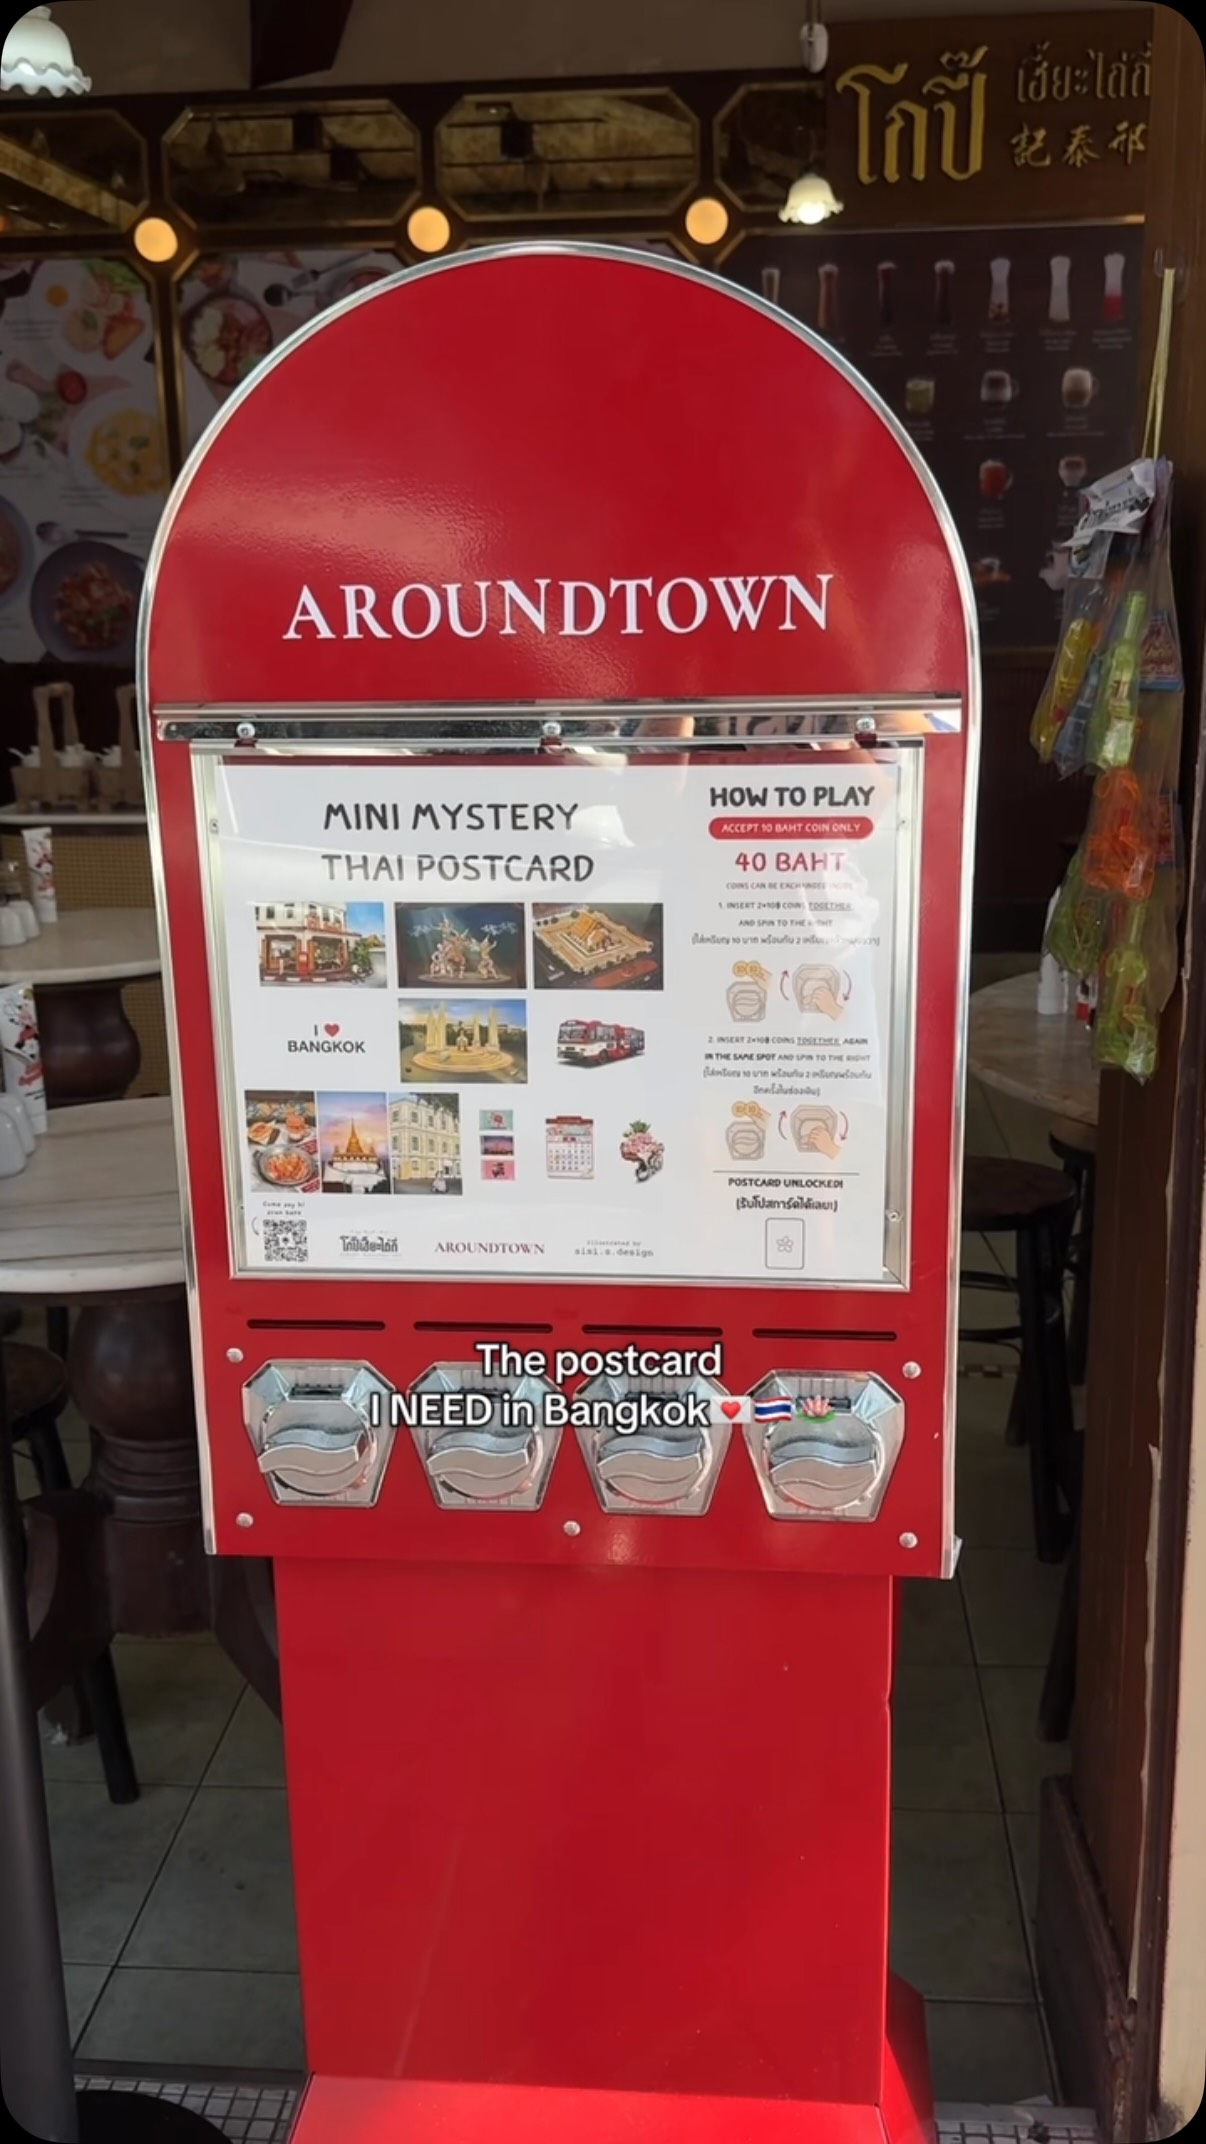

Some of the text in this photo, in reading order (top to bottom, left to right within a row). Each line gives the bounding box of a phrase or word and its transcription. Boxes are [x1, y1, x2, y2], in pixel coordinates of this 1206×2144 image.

[282, 573, 834, 641] AROUNDTOWN
[709, 785, 875, 807] HOW TO PLAY
[323, 803, 579, 831] MINI MYSTERY
[721, 822, 861, 833] ACCEPT 10 BAHT COIN ONLY
[321, 854, 595, 882] THAI POSTCARD
[735, 851, 846, 872] 40 BAHT
[739, 919, 756, 927] AND
[757, 919, 775, 927] SPIN
[777, 919, 788, 927] TO
[790, 919, 807, 927] THE
[314, 1023, 318, 1037] I
[287, 1039, 366, 1054] BANGKOK
[717, 1036, 745, 1045] INSERT
[772, 1036, 795, 1045] COINS
[842, 1037, 868, 1046] AGAIN
[704, 1053, 714, 1061] IN
[716, 1053, 732, 1061] THE
[733, 1053, 755, 1061] SAME
[756, 1053, 777, 1061] SPOT
[778, 1054, 794, 1062] AND
[796, 1054, 814, 1062] SPIN
[816, 1054, 827, 1062] TO
[828, 1054, 844, 1062] THE
[728, 1177, 844, 1189] POSTCARD UNLOCKED!
[434, 1241, 545, 1255] AROUNDTOWN
